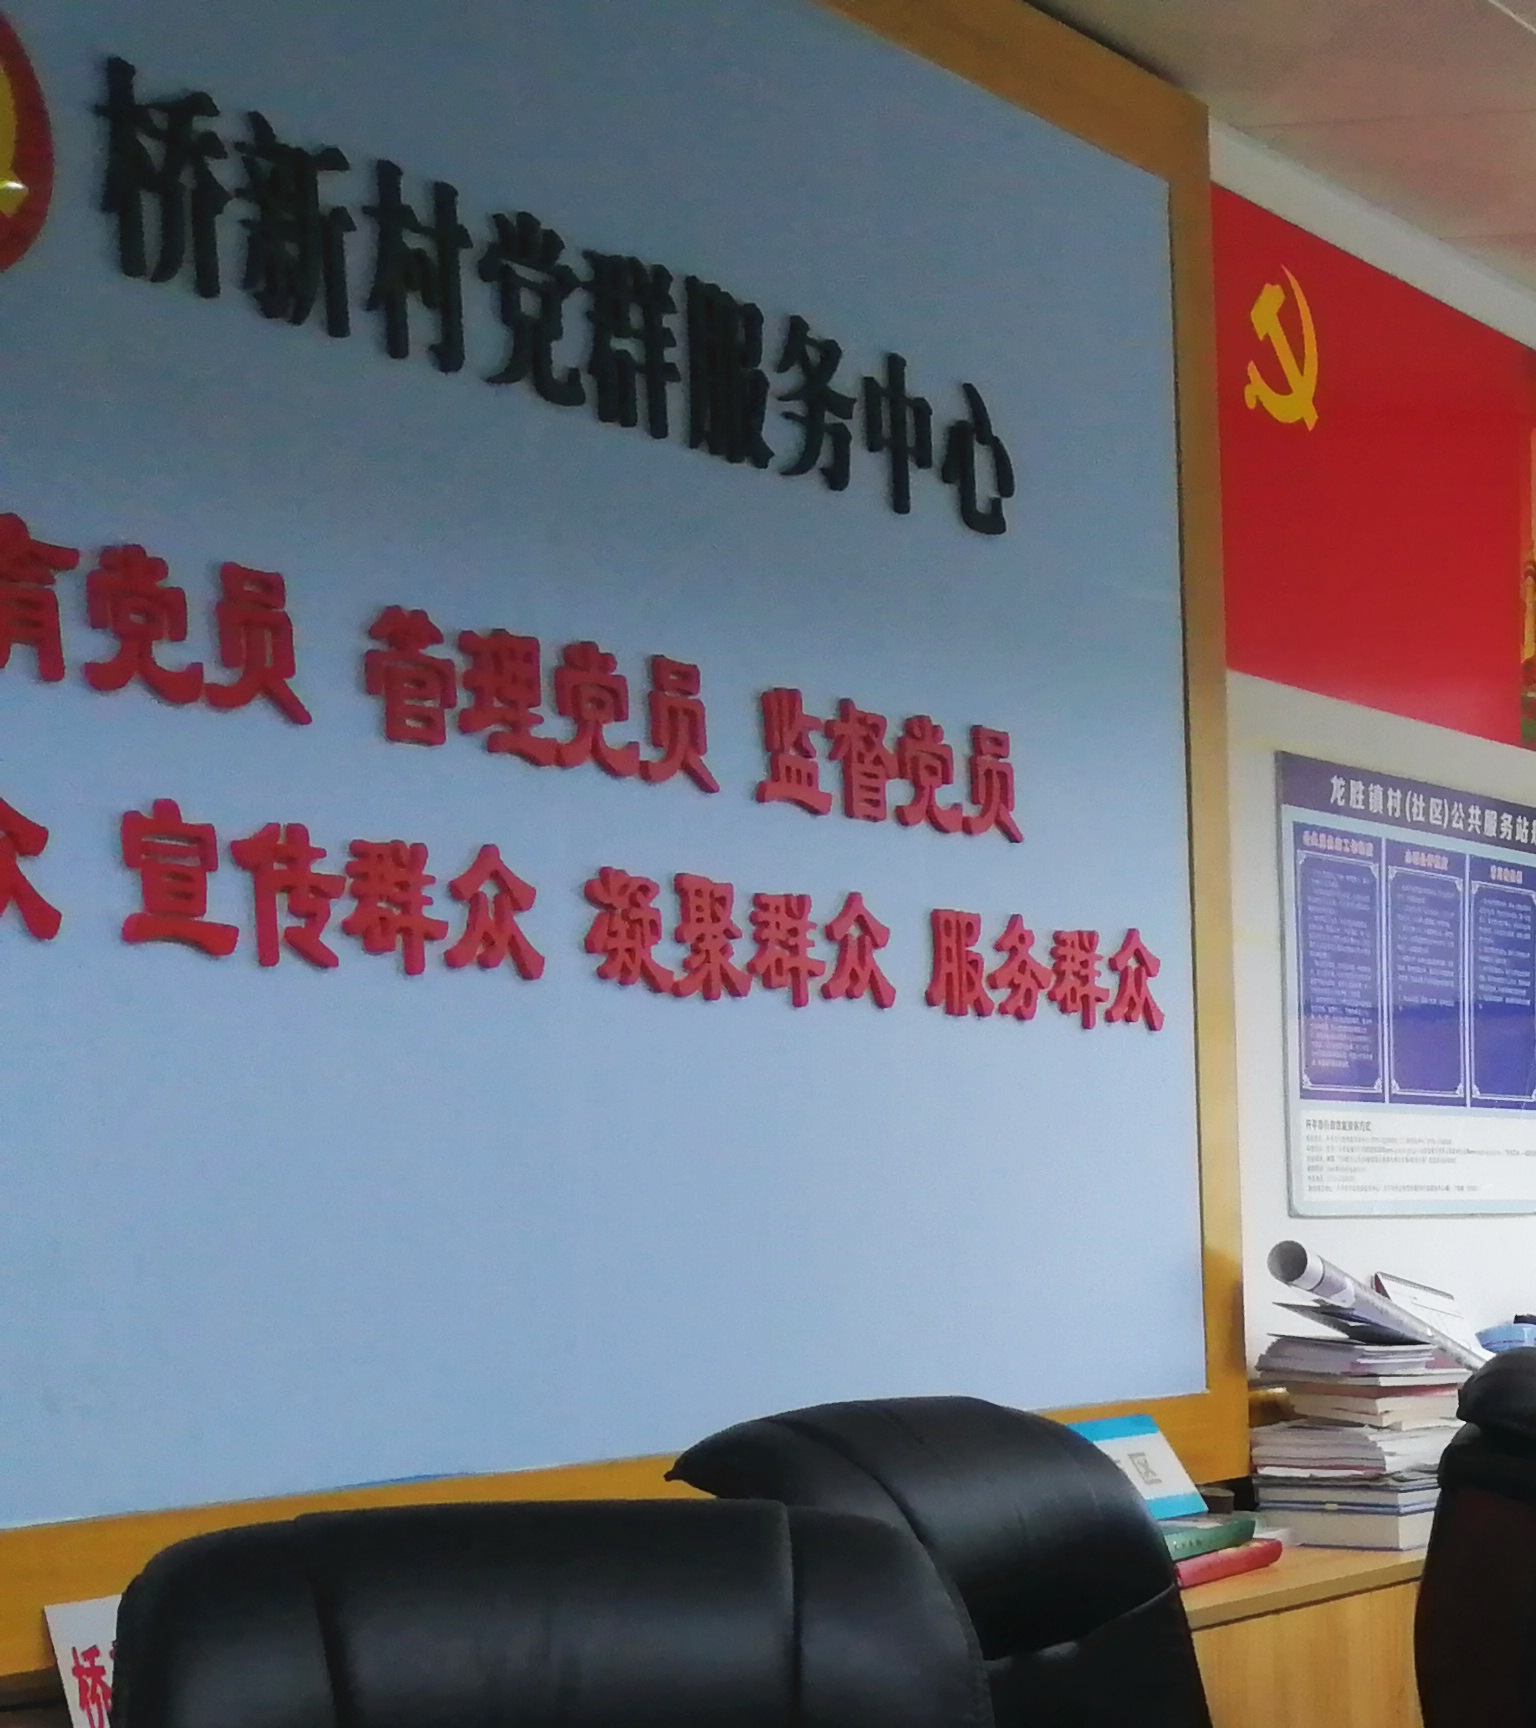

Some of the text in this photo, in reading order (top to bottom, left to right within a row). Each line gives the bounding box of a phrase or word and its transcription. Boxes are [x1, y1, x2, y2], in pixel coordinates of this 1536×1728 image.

[97, 55, 1016, 536] 桥新村党群服务中心
[364, 607, 719, 794] 管理党员
[757, 688, 1023, 843] 监督党员
[121, 800, 544, 980] 宣传群众
[585, 867, 896, 1010] 凝聚群众
[925, 909, 1164, 1031] 服务群众
